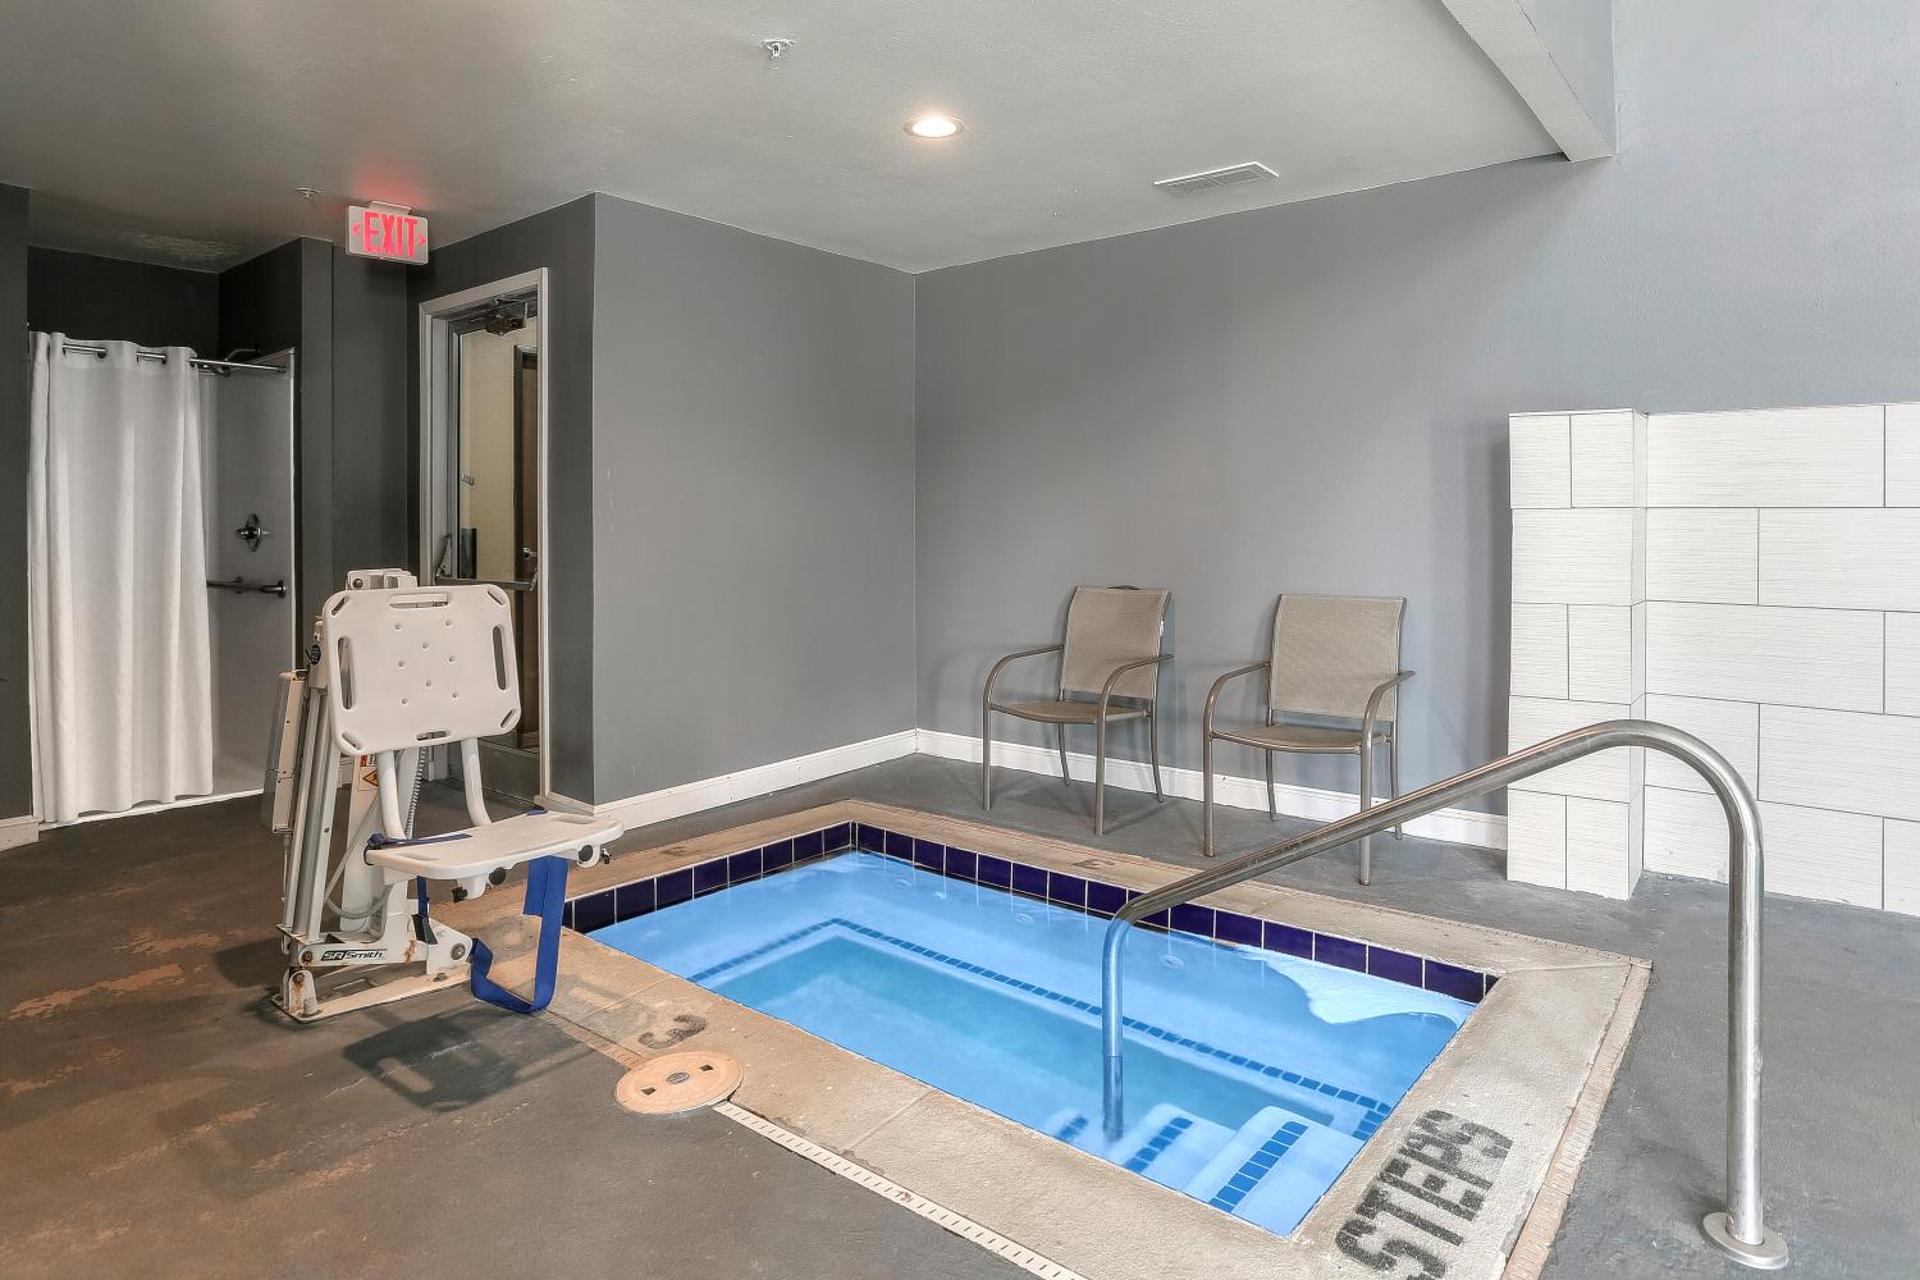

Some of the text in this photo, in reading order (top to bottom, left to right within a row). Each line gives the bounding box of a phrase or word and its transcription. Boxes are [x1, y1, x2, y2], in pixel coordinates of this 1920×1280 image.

[363, 209, 417, 258] EXIT
[322, 950, 383, 960] SR Smith
[1335, 1109, 1512, 1280] STEPS
